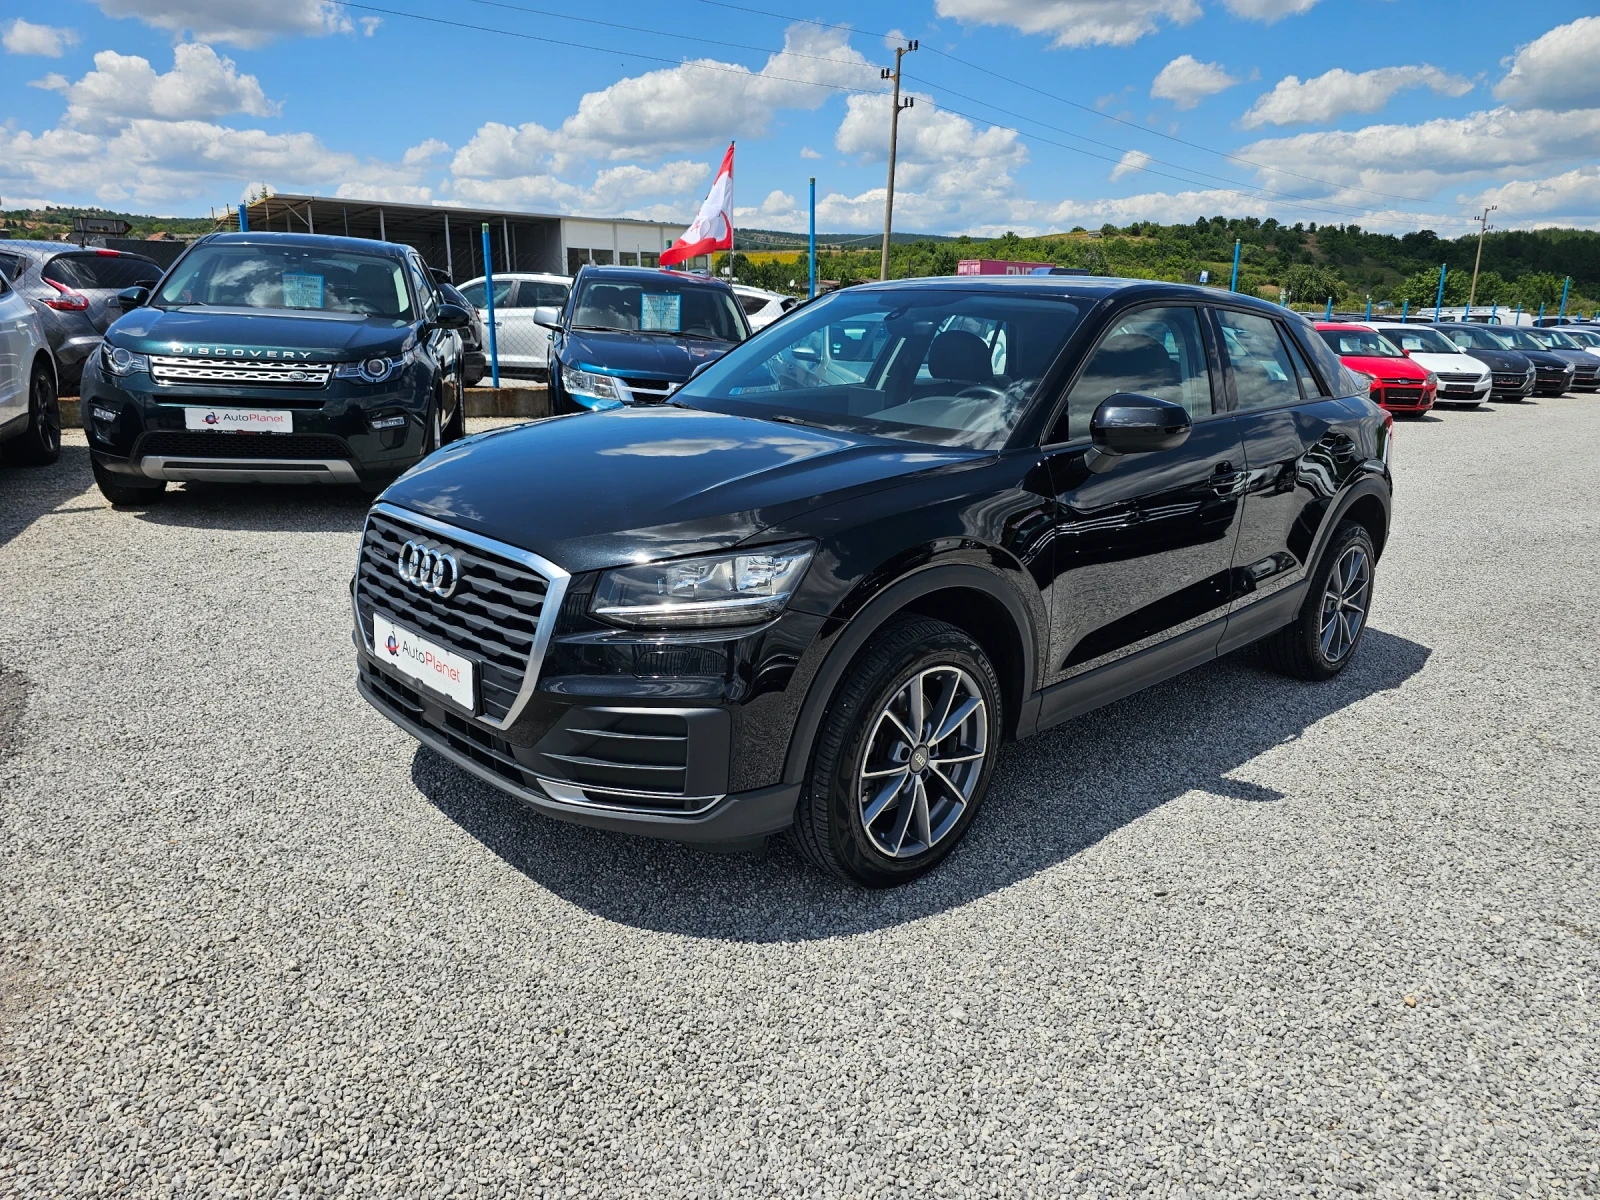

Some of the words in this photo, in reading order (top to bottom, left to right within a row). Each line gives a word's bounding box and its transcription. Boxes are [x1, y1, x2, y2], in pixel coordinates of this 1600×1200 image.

[172, 347, 312, 359] DISCOVERY
[223, 413, 284, 423] AutoPlanet
[402, 640, 461, 683] AutoPlanet
